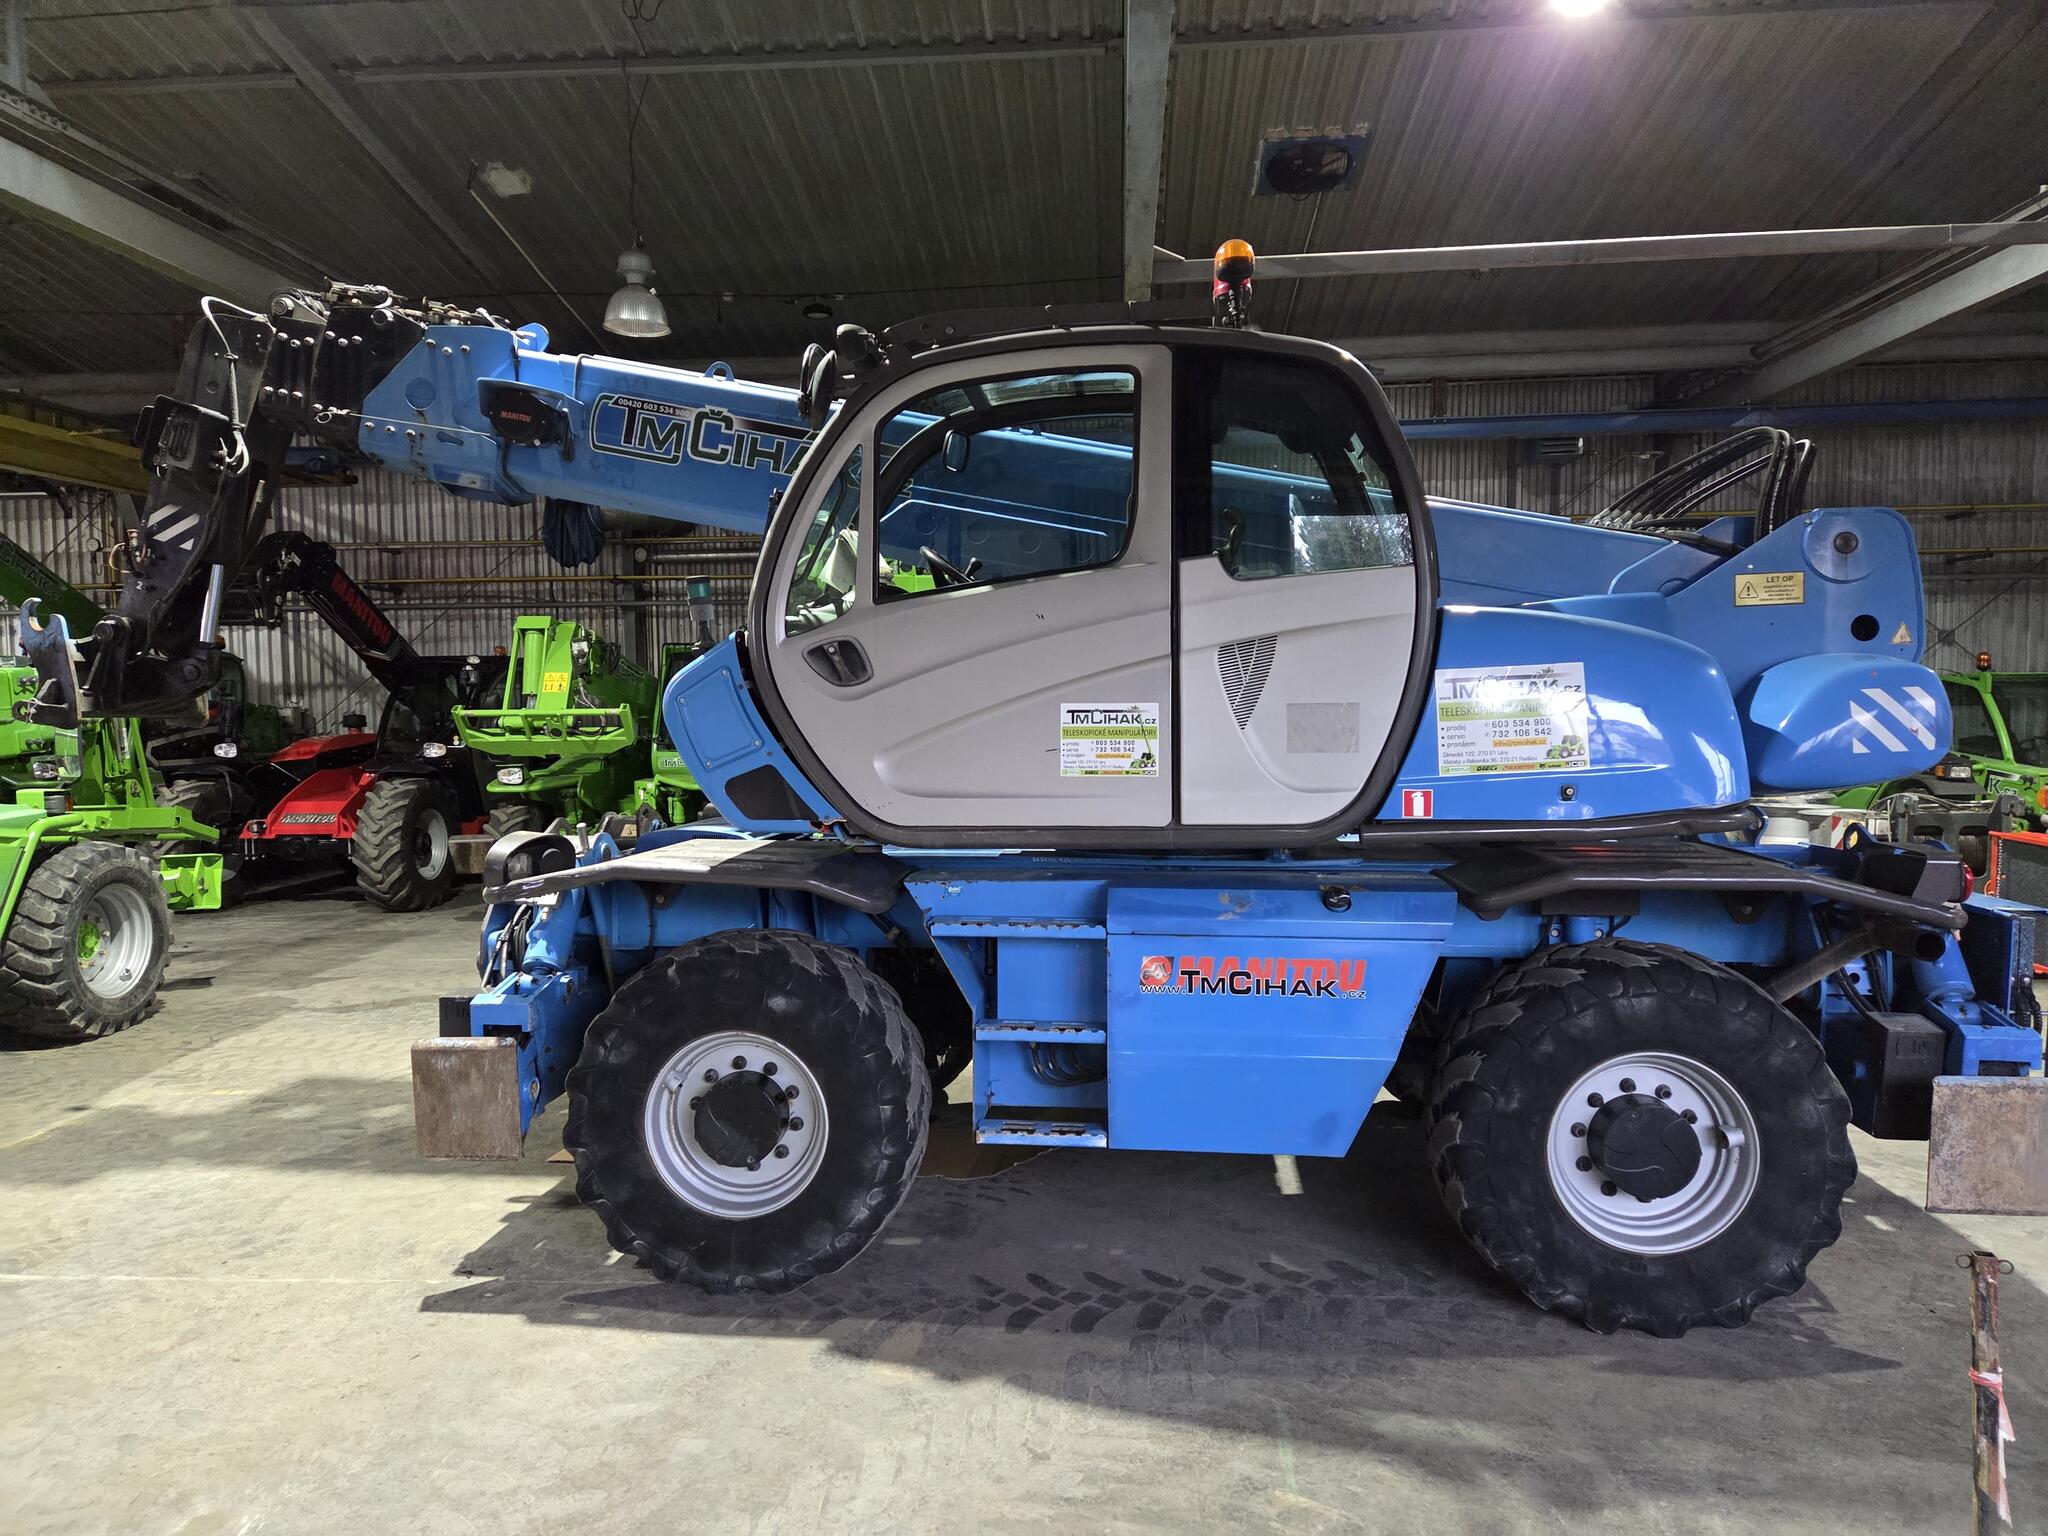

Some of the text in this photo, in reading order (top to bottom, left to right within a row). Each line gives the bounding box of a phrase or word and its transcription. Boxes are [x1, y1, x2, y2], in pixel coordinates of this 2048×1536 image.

[618, 398, 642, 409] 00420
[643, 402, 658, 411] 603
[659, 405, 674, 414] 534
[500, 410, 532, 423] MANITOU
[1782, 575, 1794, 583] OP
[331, 571, 391, 645] MANITOU
[1491, 717, 1551, 729] 603 534 900
[1492, 727, 1552, 739] 732 106 542
[1177, 955, 1368, 992] MANITOU
